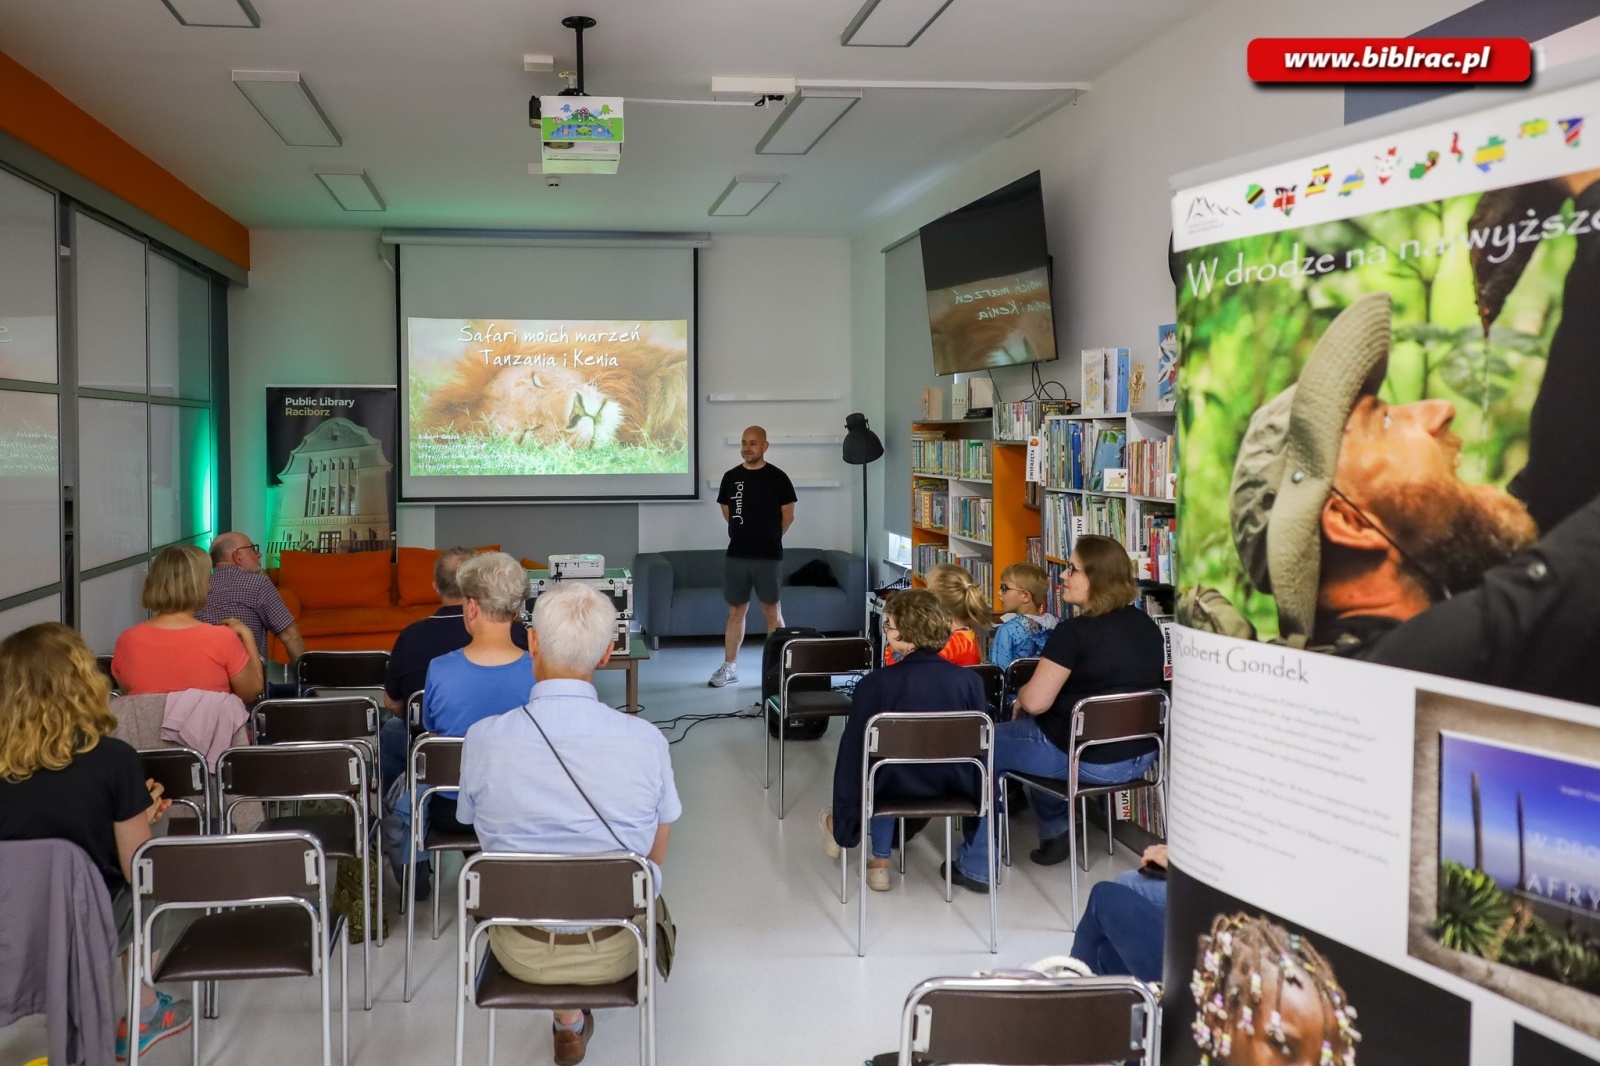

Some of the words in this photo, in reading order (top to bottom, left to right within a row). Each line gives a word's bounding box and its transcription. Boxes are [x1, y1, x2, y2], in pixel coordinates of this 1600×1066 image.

[1187, 257, 1218, 297] W
[1224, 243, 1336, 288] drodze
[1346, 244, 1387, 270] na
[457, 323, 518, 343] Safari
[524, 325, 569, 343] moich
[575, 324, 641, 343] marzeń
[478, 349, 557, 368] Tanzania
[563, 351, 567, 368] i
[573, 349, 619, 368] Kenia
[285, 397, 317, 406] Public
[319, 397, 355, 408] Library
[285, 407, 331, 416] Raciborz
[730, 481, 744, 525] Jambo!
[1164, 627, 1172, 665] MINECRAFT
[1175, 633, 1223, 664] Robert
[1226, 646, 1310, 684] Gondek
[1121, 789, 1130, 818] NAUK
[161, 1009, 176, 1028] N
